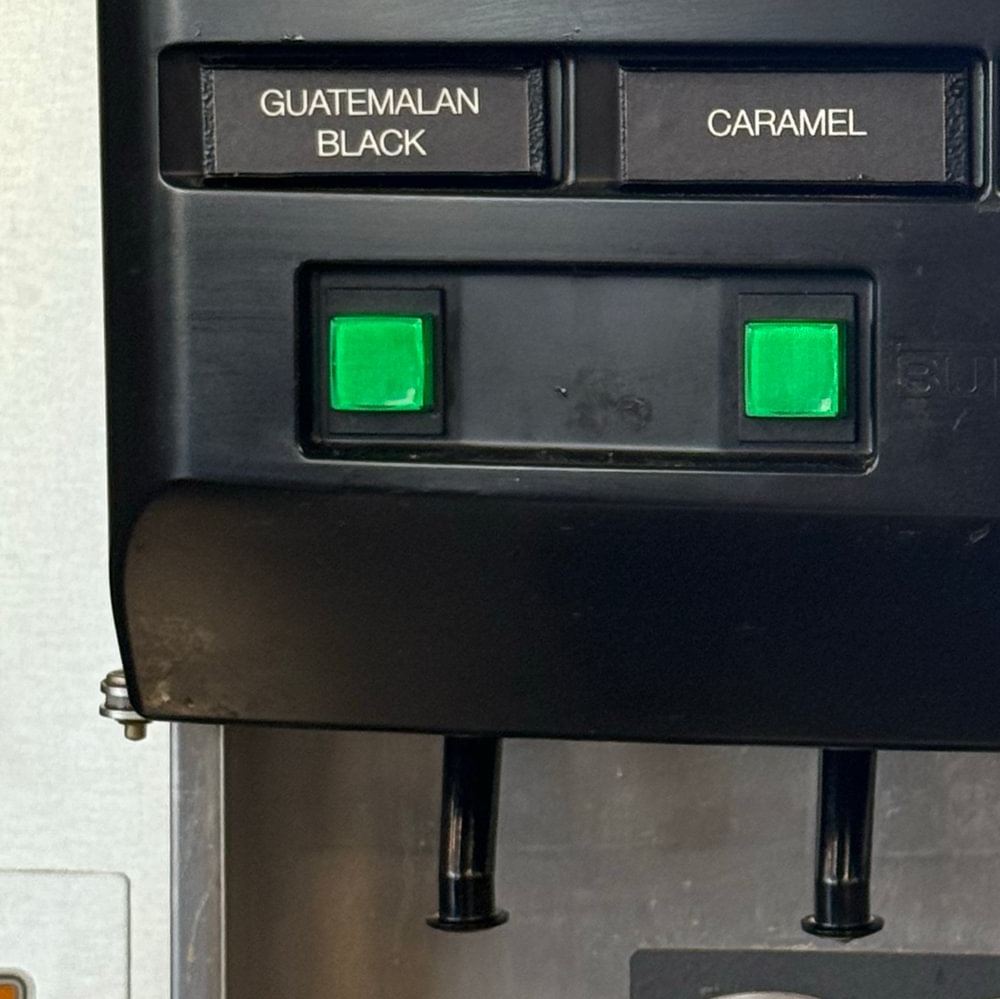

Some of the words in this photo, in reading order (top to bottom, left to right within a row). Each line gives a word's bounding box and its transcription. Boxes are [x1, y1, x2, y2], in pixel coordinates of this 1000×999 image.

[259, 87, 482, 119] GUATEMALAN
[707, 108, 869, 139] CARAMEL
[316, 129, 428, 159] BLACK
